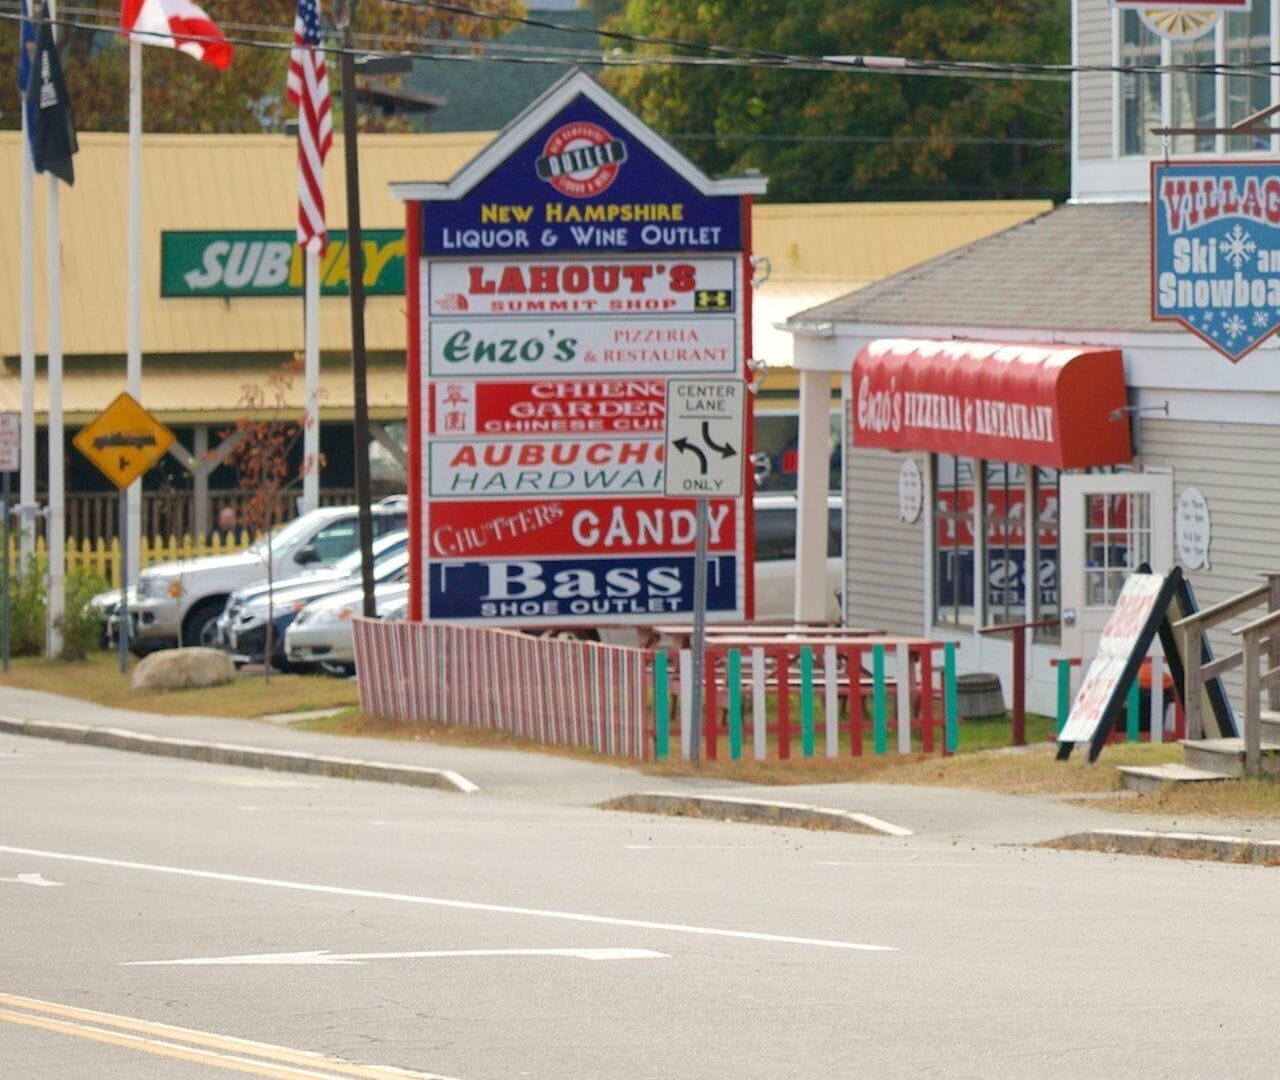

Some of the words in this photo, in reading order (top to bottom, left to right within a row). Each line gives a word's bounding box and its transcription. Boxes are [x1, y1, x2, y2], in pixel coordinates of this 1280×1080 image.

[549, 143, 613, 176] OUTLET
[481, 204, 534, 223] NEW
[546, 203, 683, 222] HAMPSHIRE
[443, 228, 529, 249] LIQUOR
[541, 229, 558, 247] &
[571, 226, 628, 246] WINE
[641, 225, 722, 246] OUTLET
[1173, 237, 1217, 274] Ski
[468, 265, 696, 295] LAHOUT'S
[491, 300, 598, 312] SUMMIT
[609, 298, 677, 310] SHOP
[613, 329, 698, 343] PIZZERIA
[443, 329, 578, 364] Enzo's
[583, 351, 597, 364] &
[603, 348, 728, 363] RESTAURANT
[677, 385, 735, 399] CENTER
[509, 401, 665, 418] GARDEN
[685, 398, 725, 411] LANE
[857, 375, 902, 433] Enzo's
[904, 391, 962, 432] PIZZERIA
[975, 398, 1054, 442] RESTAURANT
[484, 419, 604, 432] CHINESE
[450, 443, 664, 467] AUBUCH
[451, 470, 664, 491] HARDWA
[682, 478, 724, 492] ONLY
[571, 505, 729, 547] CANDY
[480, 562, 683, 602] Bass
[480, 600, 559, 616] SHOE
[570, 598, 683, 614] OUTLET
